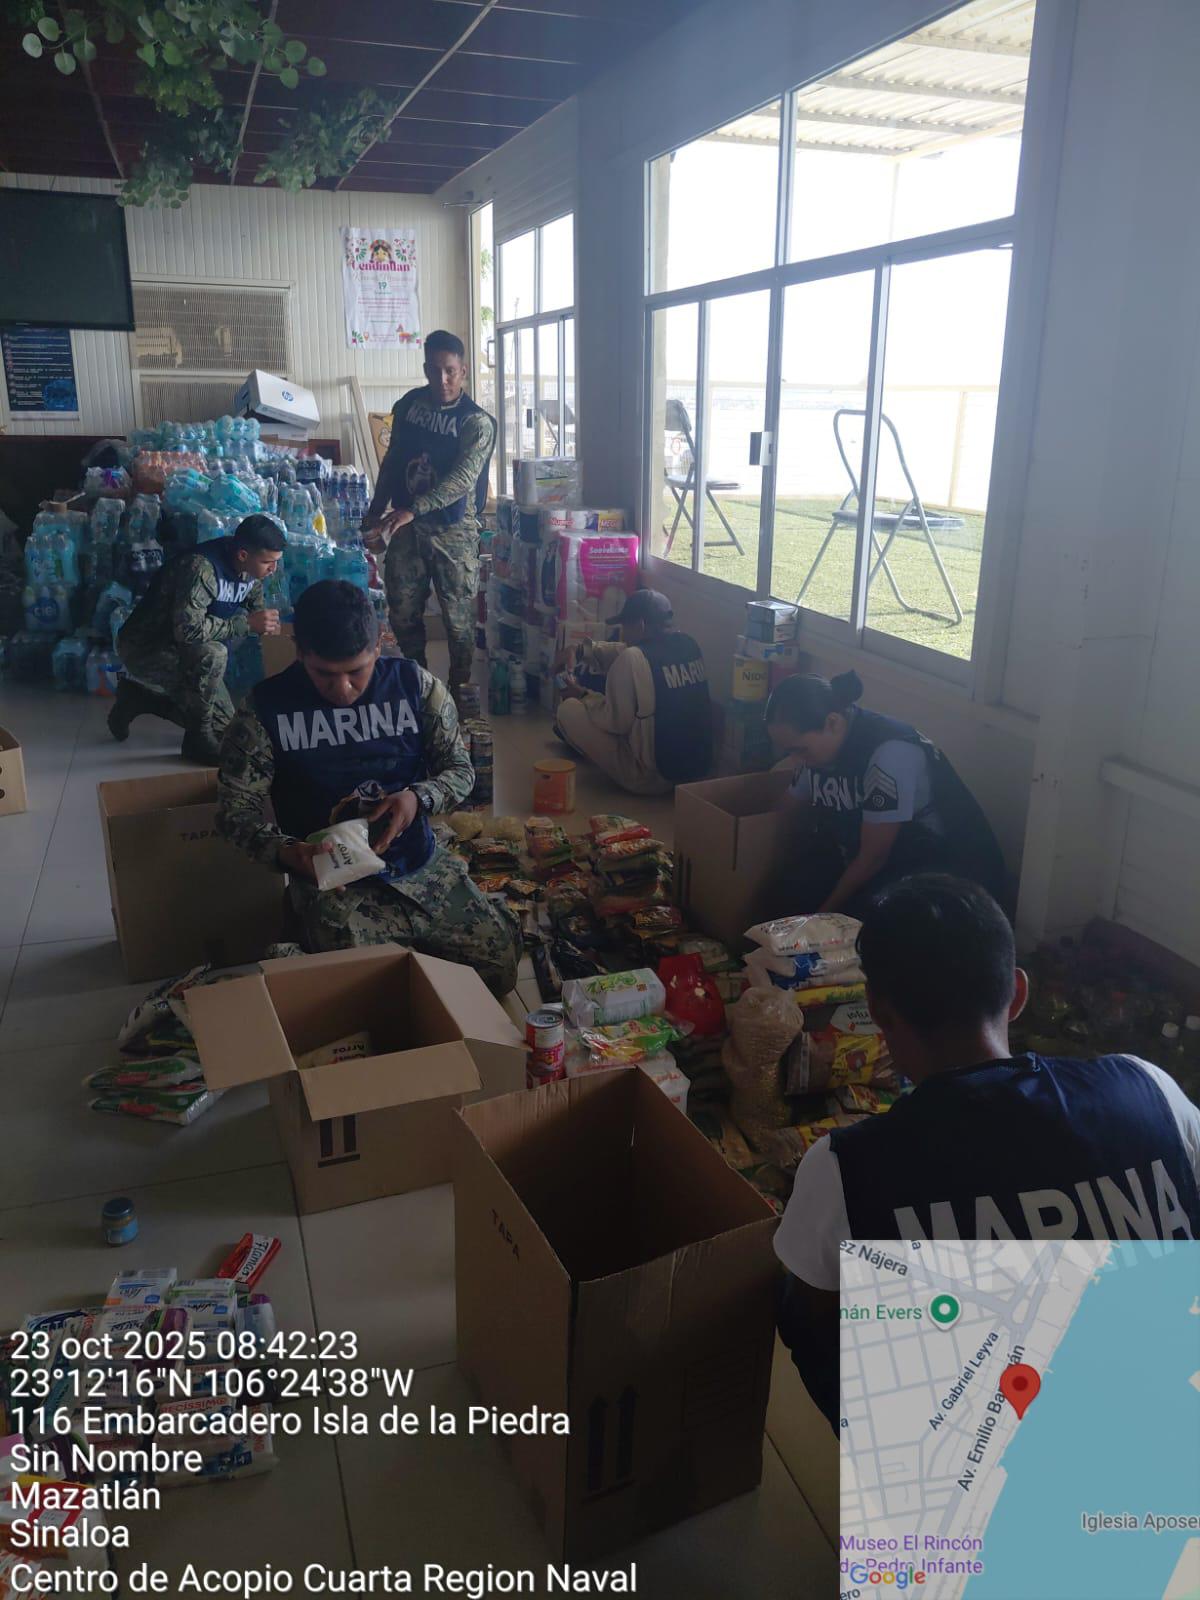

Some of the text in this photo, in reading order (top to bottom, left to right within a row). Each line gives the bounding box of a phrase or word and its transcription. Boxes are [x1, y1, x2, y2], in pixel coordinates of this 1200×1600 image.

[406, 404, 458, 438] MARINA
[276, 699, 419, 751] MARINA
[893, 1159, 1195, 1241] MARINA
